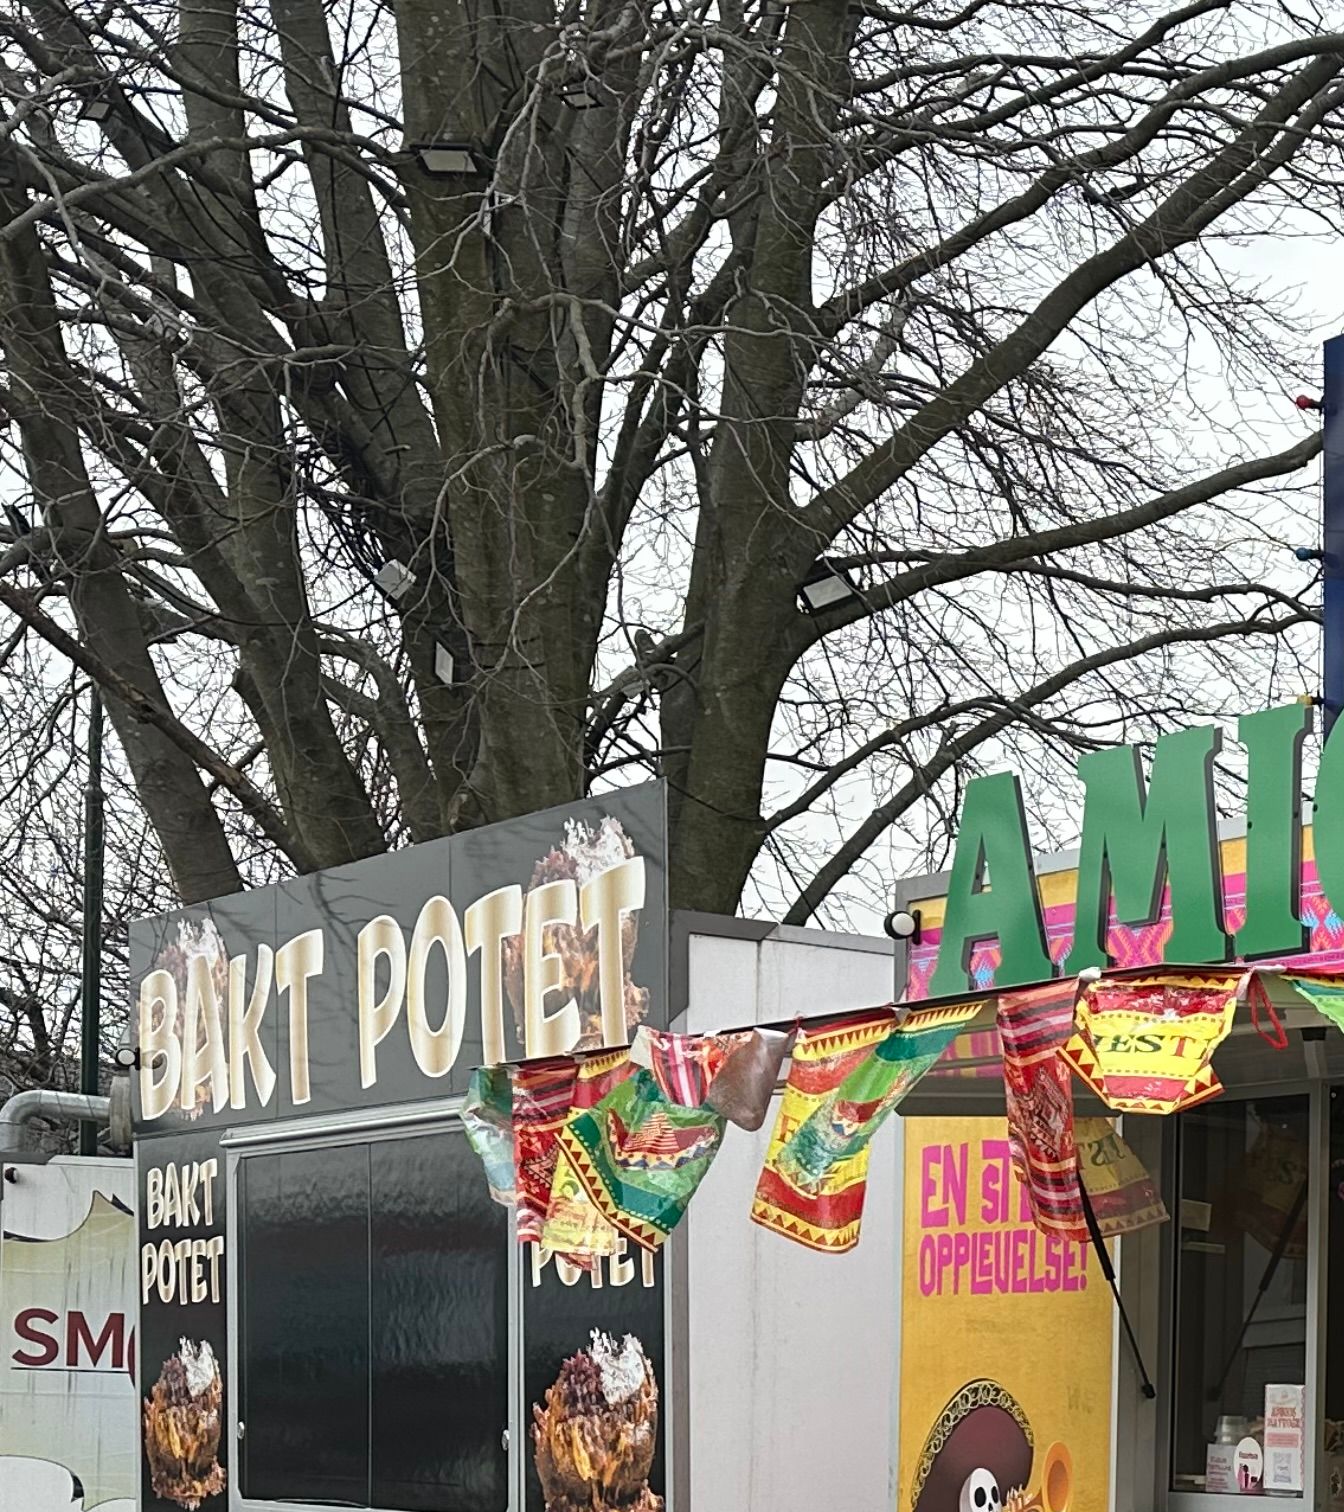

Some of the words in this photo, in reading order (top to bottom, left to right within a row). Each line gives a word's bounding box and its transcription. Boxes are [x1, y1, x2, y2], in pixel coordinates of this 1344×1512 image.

[139, 928, 324, 1121] BAKT
[357, 855, 646, 1090] POTET
[146, 1157, 218, 1230] BAKT
[920, 1141, 969, 1229] EN
[142, 1235, 225, 1306] POTET
[12, 1307, 136, 1390] SM
